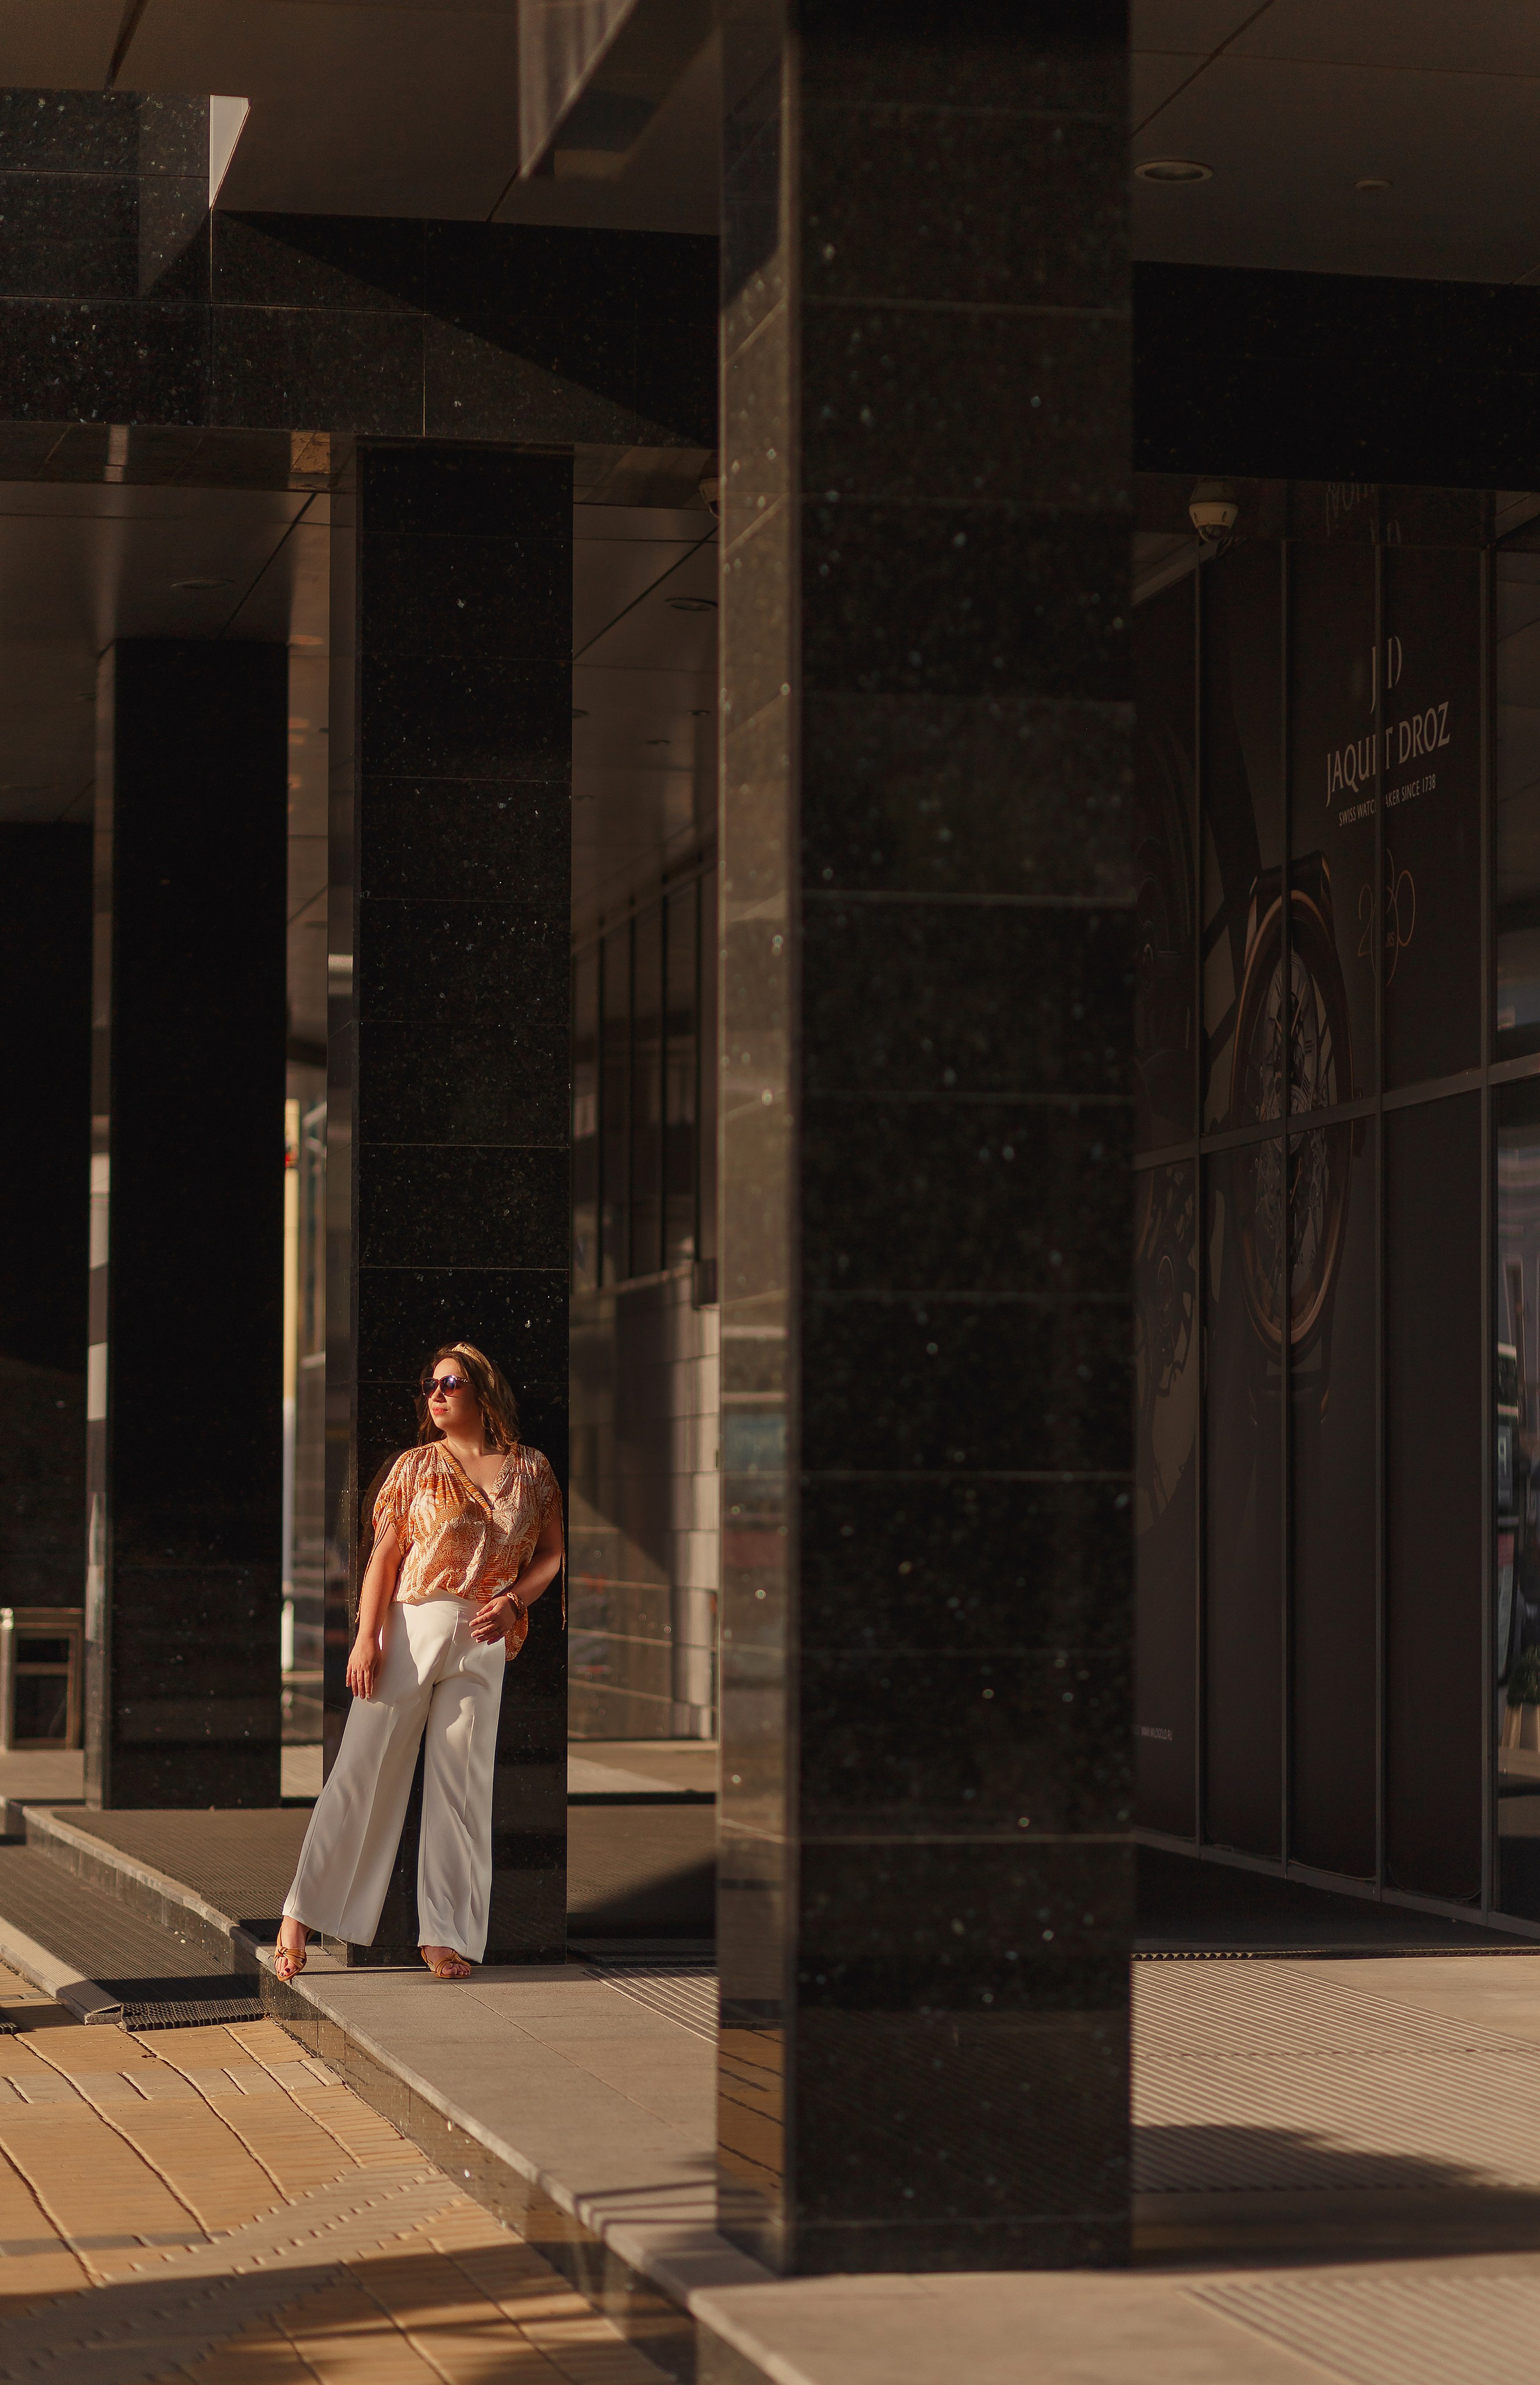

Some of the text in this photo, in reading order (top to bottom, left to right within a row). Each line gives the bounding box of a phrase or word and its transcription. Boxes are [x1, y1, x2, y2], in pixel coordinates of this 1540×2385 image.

[1398, 700, 1451, 765] DROZ
[1338, 773, 1437, 827] SWISS WATCAKER SINCE 1738
